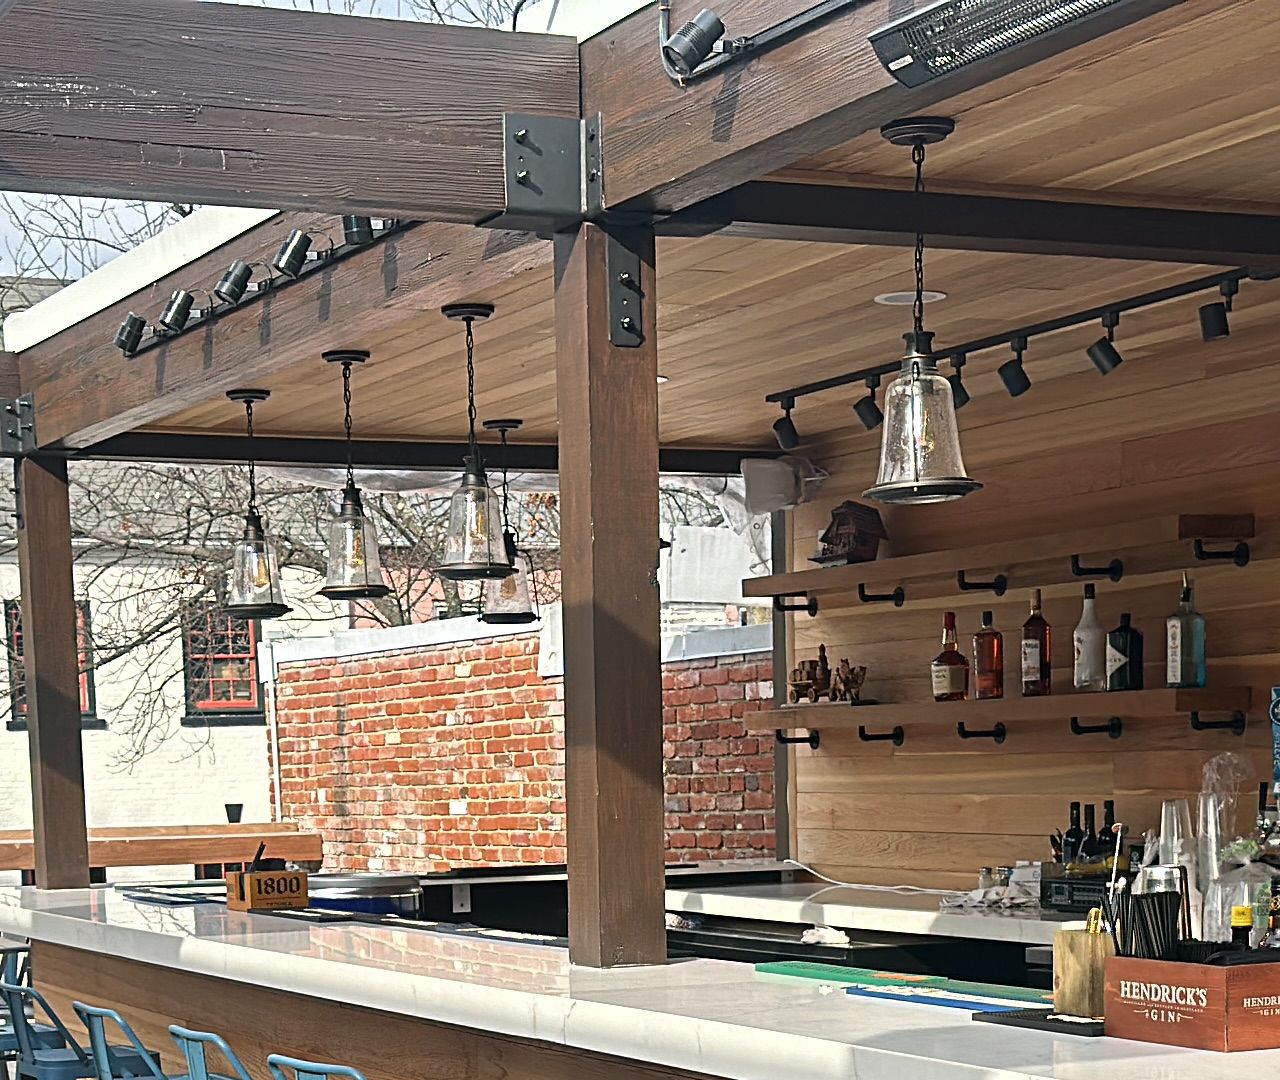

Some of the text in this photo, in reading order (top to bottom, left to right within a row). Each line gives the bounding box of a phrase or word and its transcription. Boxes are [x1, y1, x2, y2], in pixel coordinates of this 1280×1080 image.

[256, 876, 300, 895] 1800
[1120, 981, 1207, 1008] HENDRICK'S
[1150, 1009, 1176, 1023] GIN
